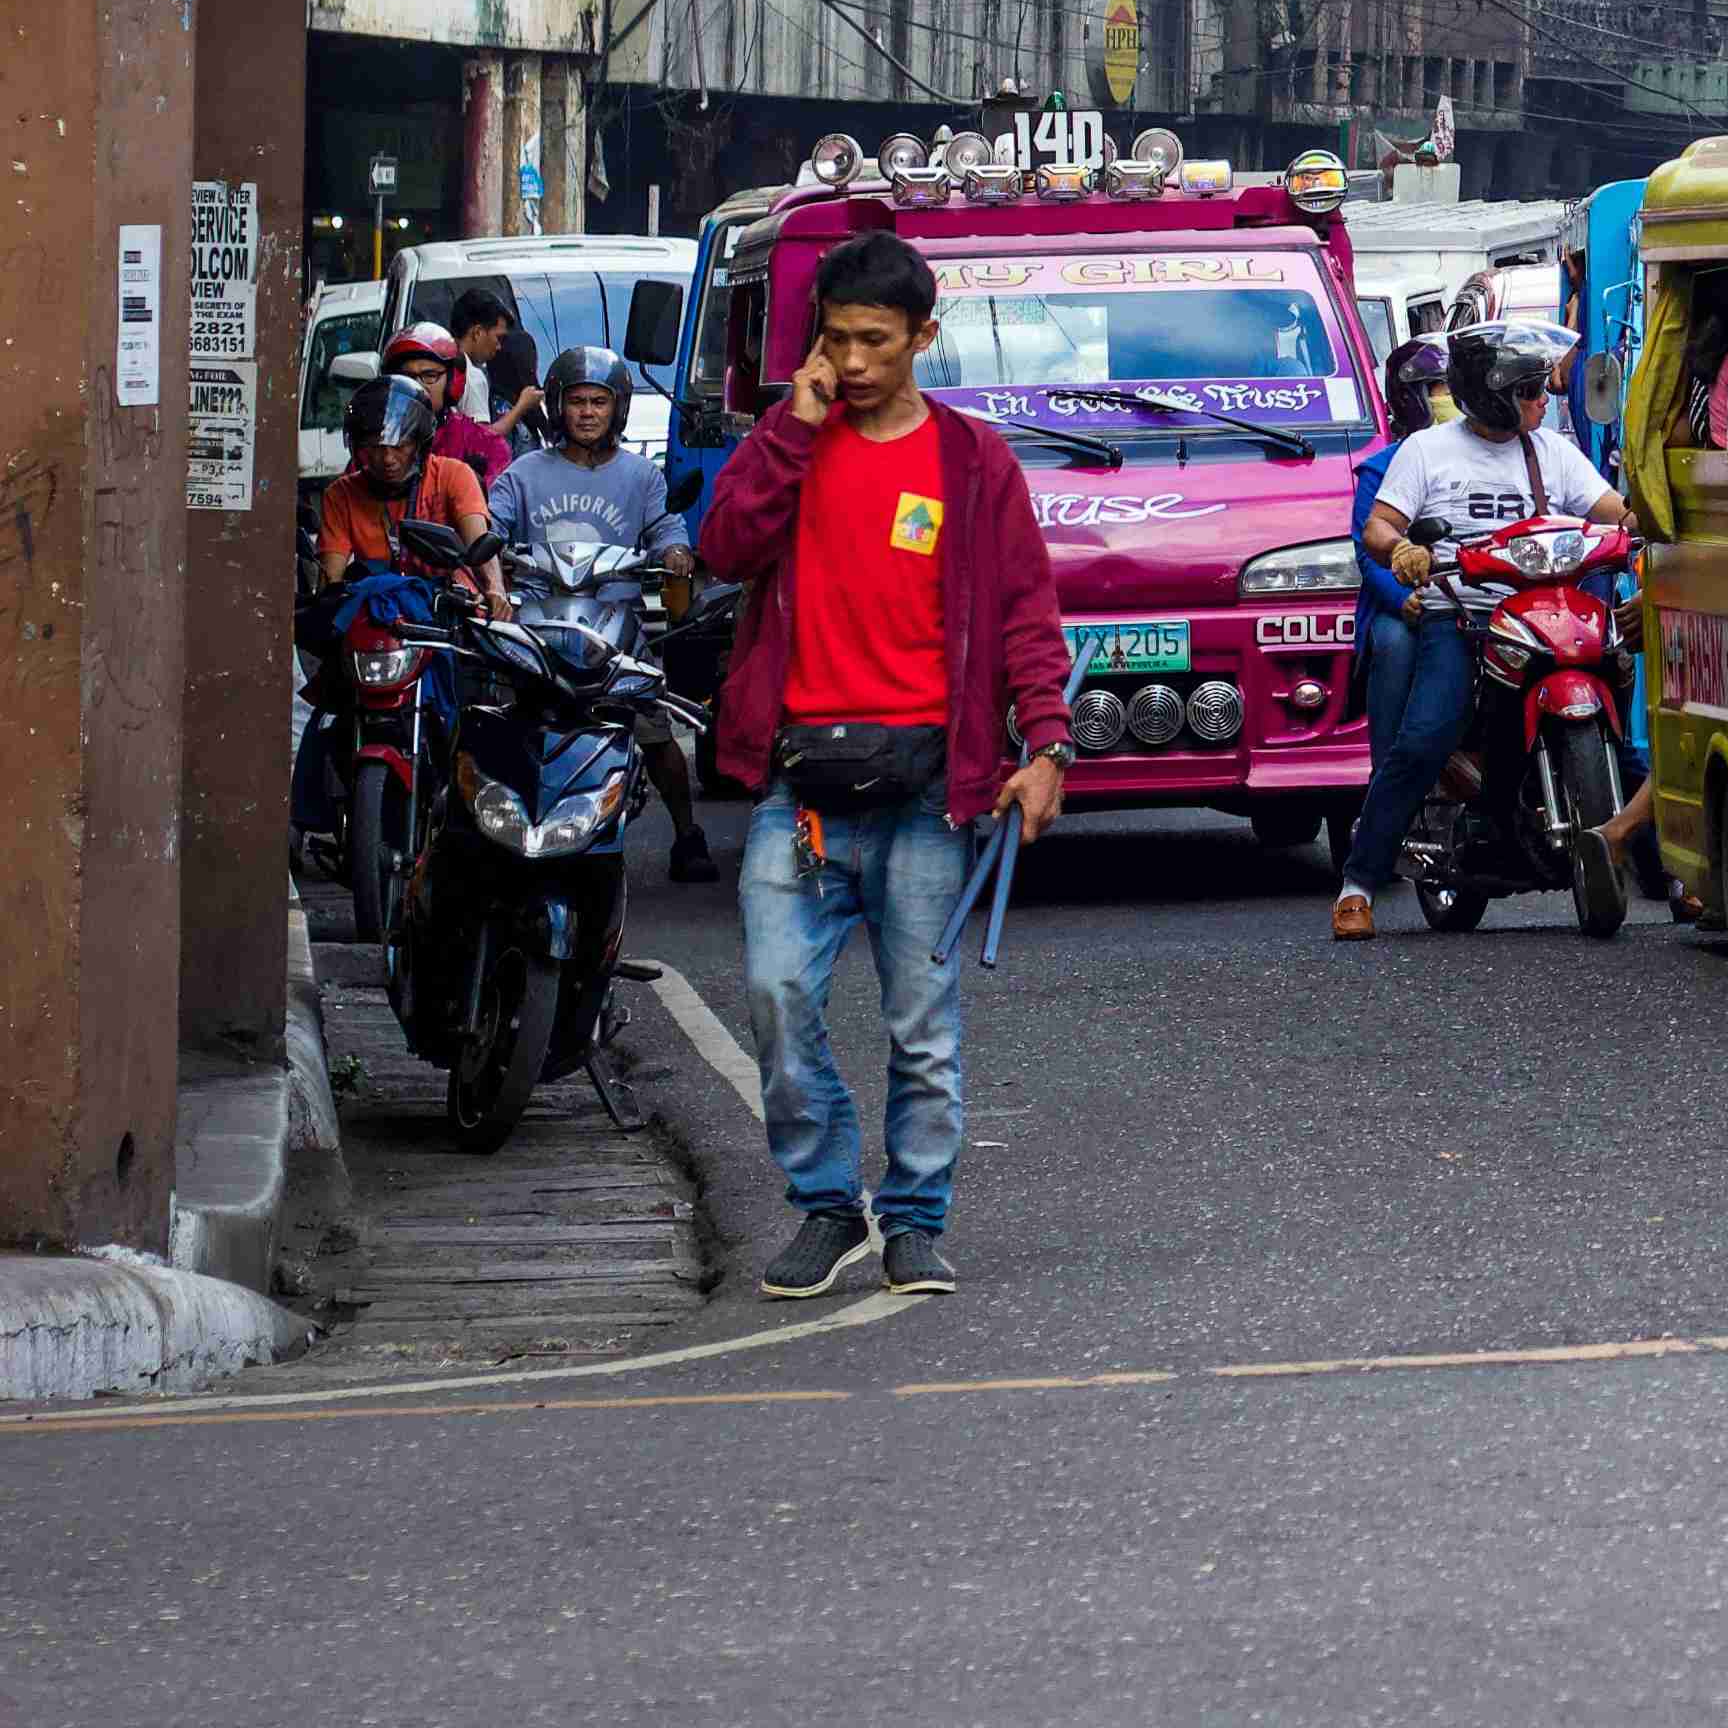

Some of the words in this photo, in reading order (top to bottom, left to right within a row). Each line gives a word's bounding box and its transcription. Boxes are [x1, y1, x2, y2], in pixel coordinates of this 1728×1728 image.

[1014, 111, 1103, 170] 14D
[1061, 256, 1285, 288] GIRL
[194, 302, 231, 311] SECRETS
[234, 302, 245, 311] OF
[195, 311, 214, 319] THE
[217, 311, 243, 320] EXAM
[977, 390, 1038, 419] In
[1203, 383, 1322, 412] Trust
[529, 493, 627, 537] CALIFORNIA
[1127, 627, 1180, 659] 205
